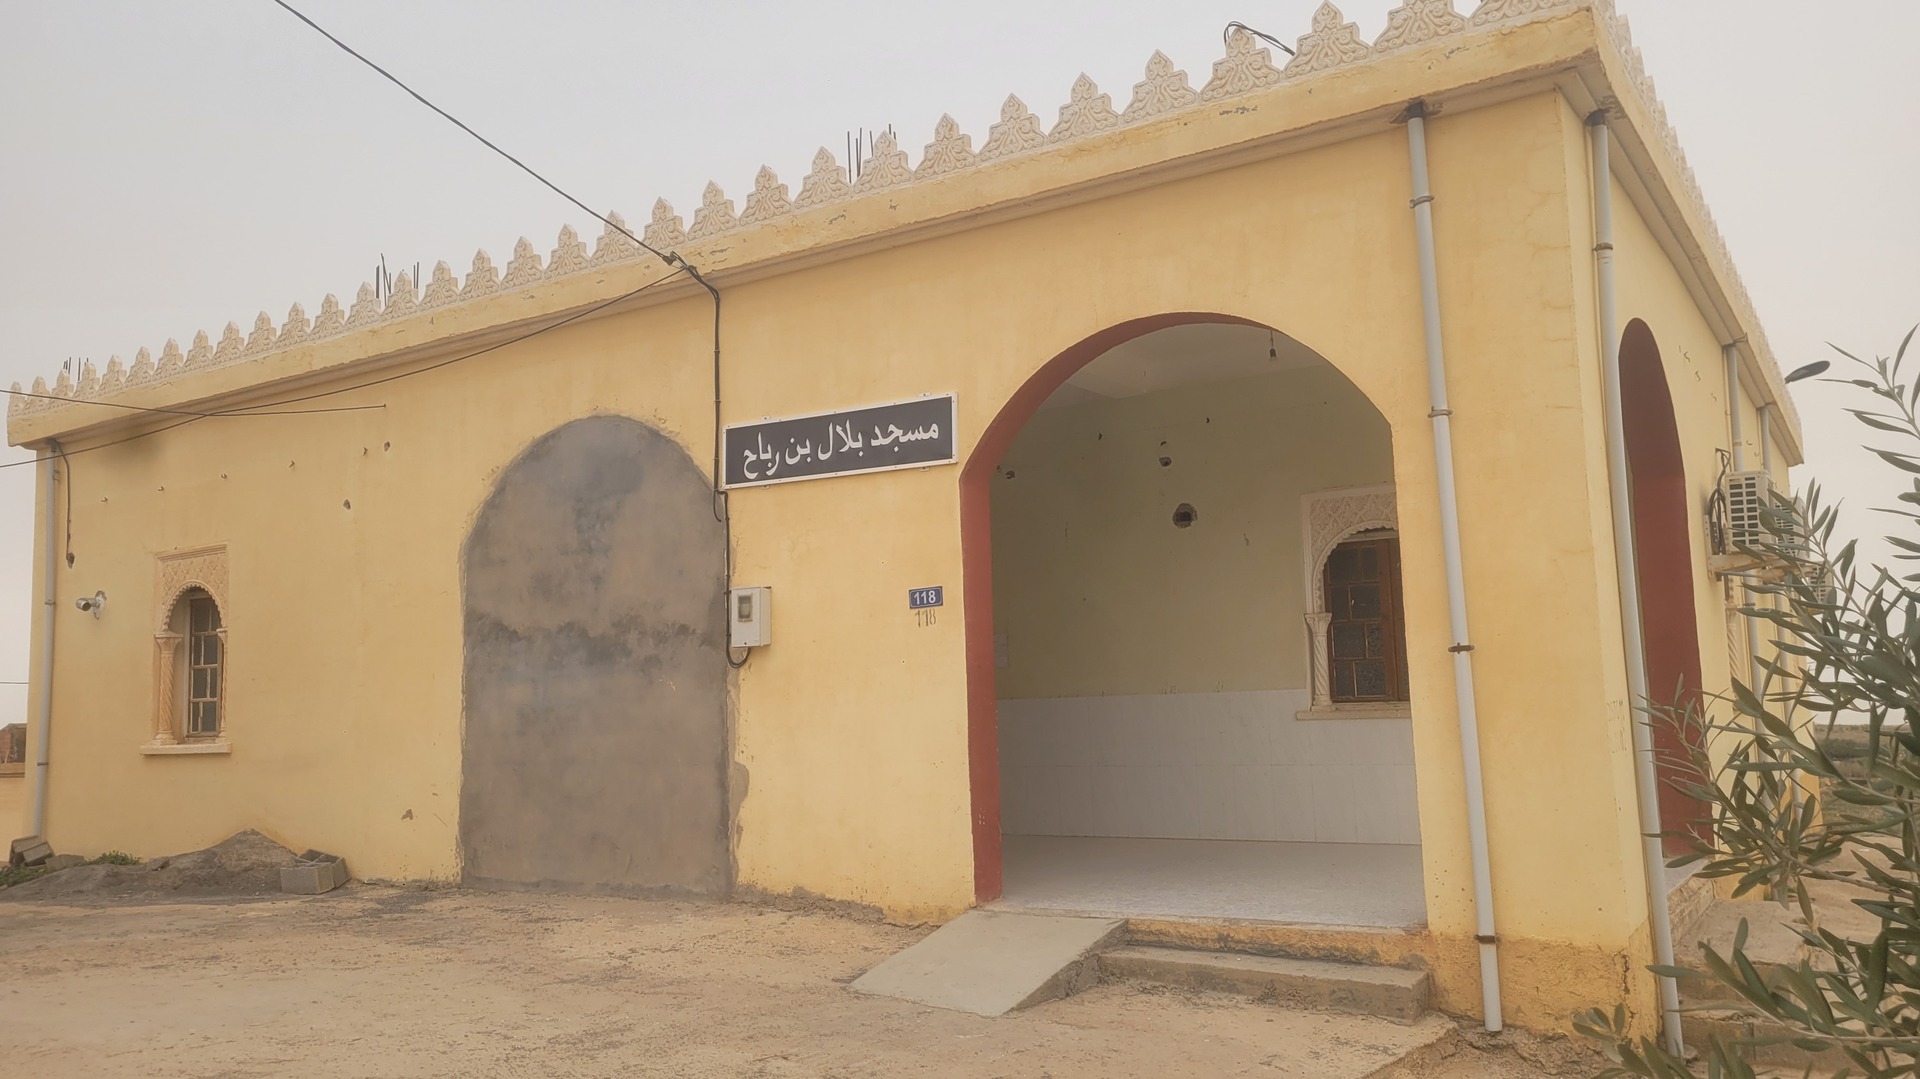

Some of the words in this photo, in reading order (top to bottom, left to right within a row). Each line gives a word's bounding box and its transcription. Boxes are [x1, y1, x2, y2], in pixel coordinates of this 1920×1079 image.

[785, 436, 812, 465] بن
[817, 419, 864, 460] بلال
[870, 421, 939, 453] مسجد
[743, 431, 780, 480] رباح
[914, 590, 936, 605] 118
